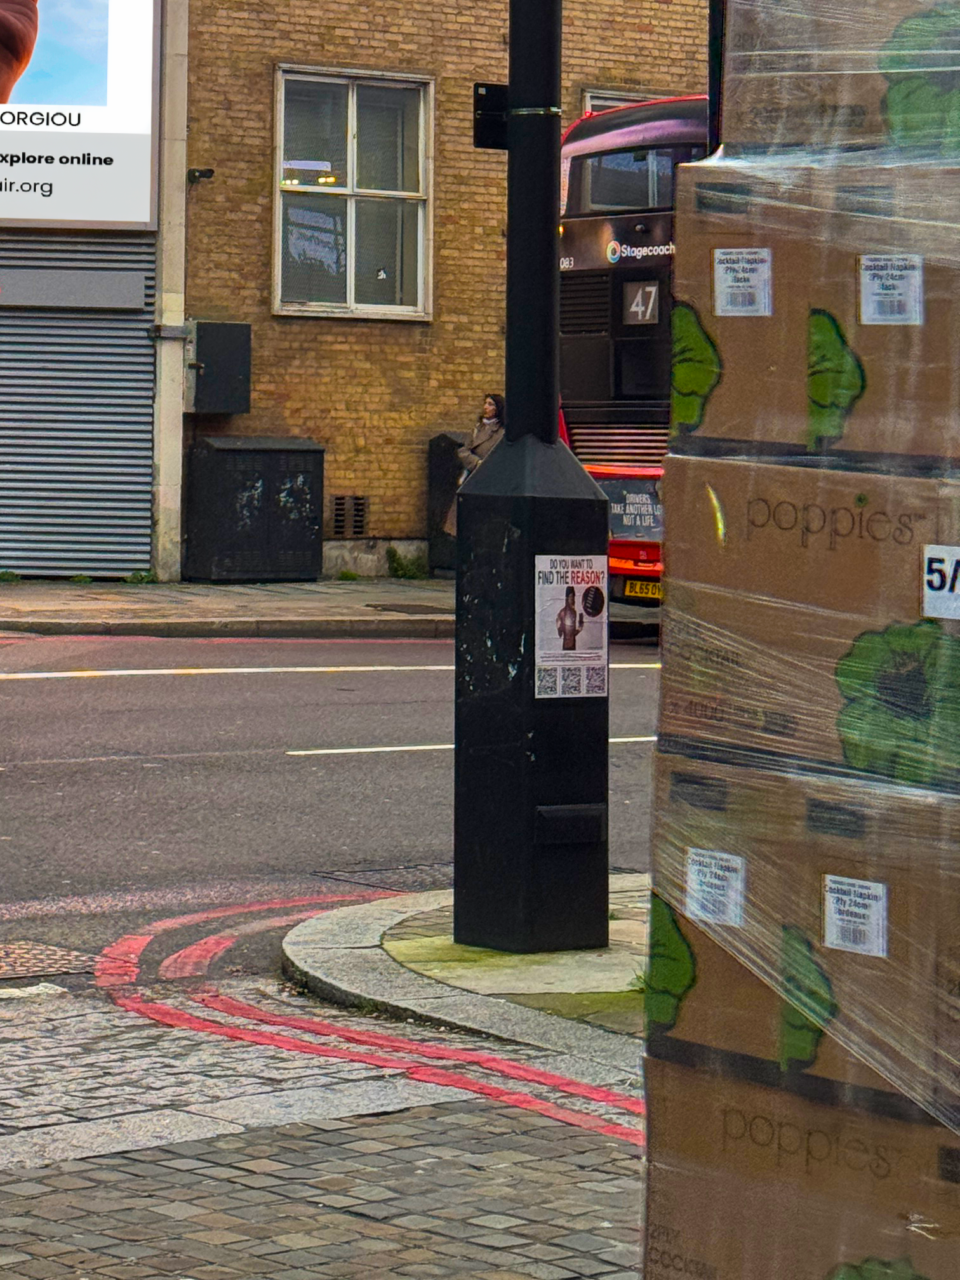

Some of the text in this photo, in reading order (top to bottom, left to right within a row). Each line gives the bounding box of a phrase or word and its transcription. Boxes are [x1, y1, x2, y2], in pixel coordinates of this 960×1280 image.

[58, 152, 114, 166] online
[621, 242, 676, 260] Stagecoach
[629, 286, 658, 320] 47
[611, 503, 625, 515] TAKE
[625, 503, 652, 515] ANOTHER
[622, 514, 635, 526] NOT
[635, 515, 641, 526] A
[747, 493, 914, 550] poppies
[550, 558, 593, 570] DO YOU WANT TO
[538, 570, 605, 585] FIND THE REASON?
